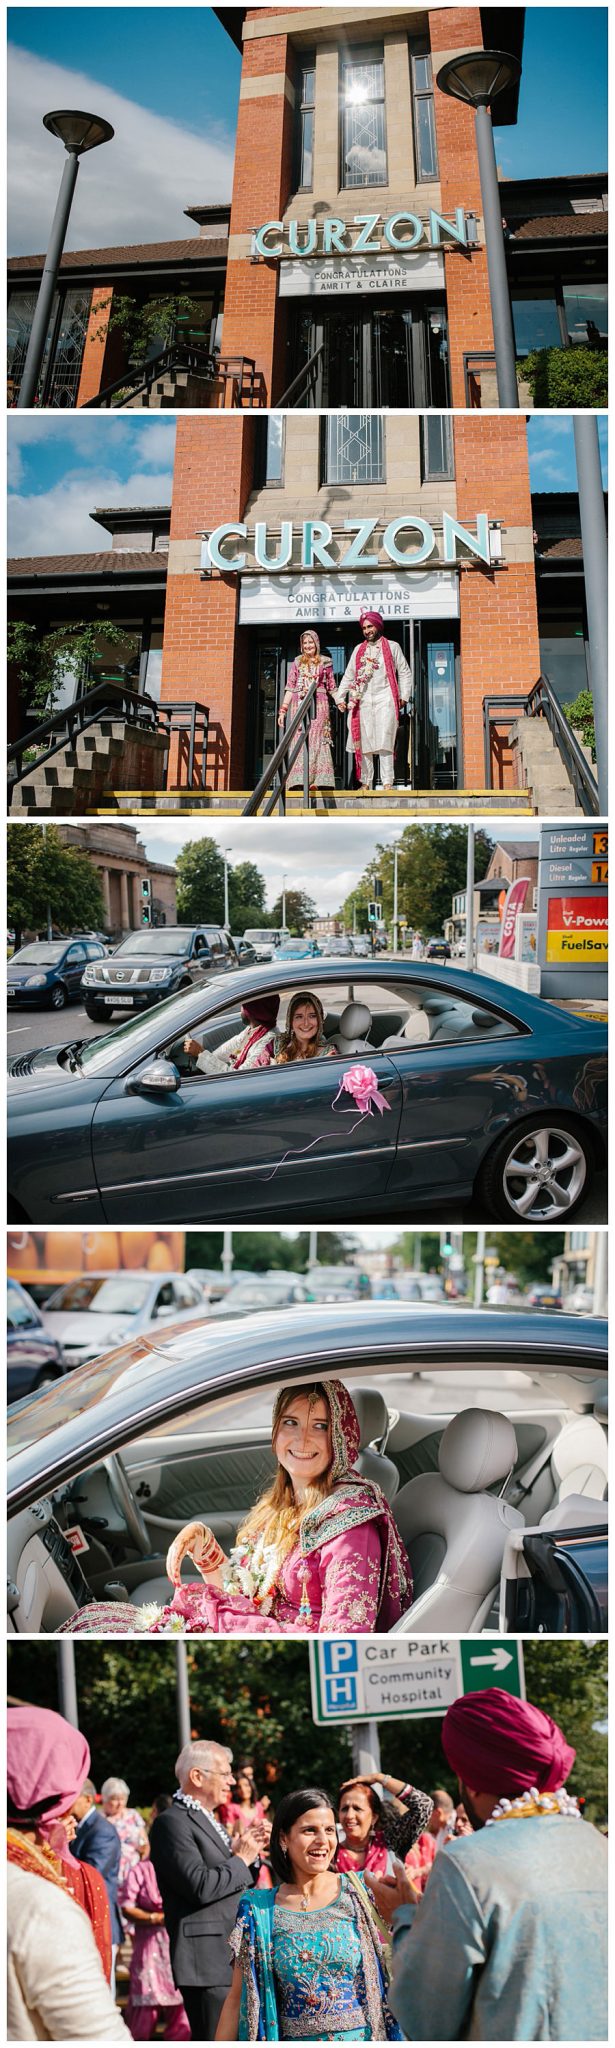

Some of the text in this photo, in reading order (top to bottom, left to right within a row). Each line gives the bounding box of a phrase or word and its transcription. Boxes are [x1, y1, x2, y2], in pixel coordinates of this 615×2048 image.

[254, 207, 468, 258] CURZON
[314, 268, 407, 280] CONGRATULATIONS
[320, 279, 408, 291] AMRIT & CLAIRE
[207, 510, 491, 572] CURZON
[287, 590, 411, 604] CONGRATULATIONS
[295, 606, 336, 617] AMRIT
[344, 606, 352, 616] &
[550, 833, 587, 844] Unleaded
[550, 845, 567, 853] Litre
[549, 863, 573, 872] Diesel
[549, 874, 566, 882] Litre
[503, 902, 517, 937] COSTA
[331, 1641, 353, 1673] P
[365, 1641, 450, 1661] Car Park
[369, 1667, 452, 1686] Community
[331, 1678, 353, 1703] H
[381, 1687, 443, 1705] Hospital
